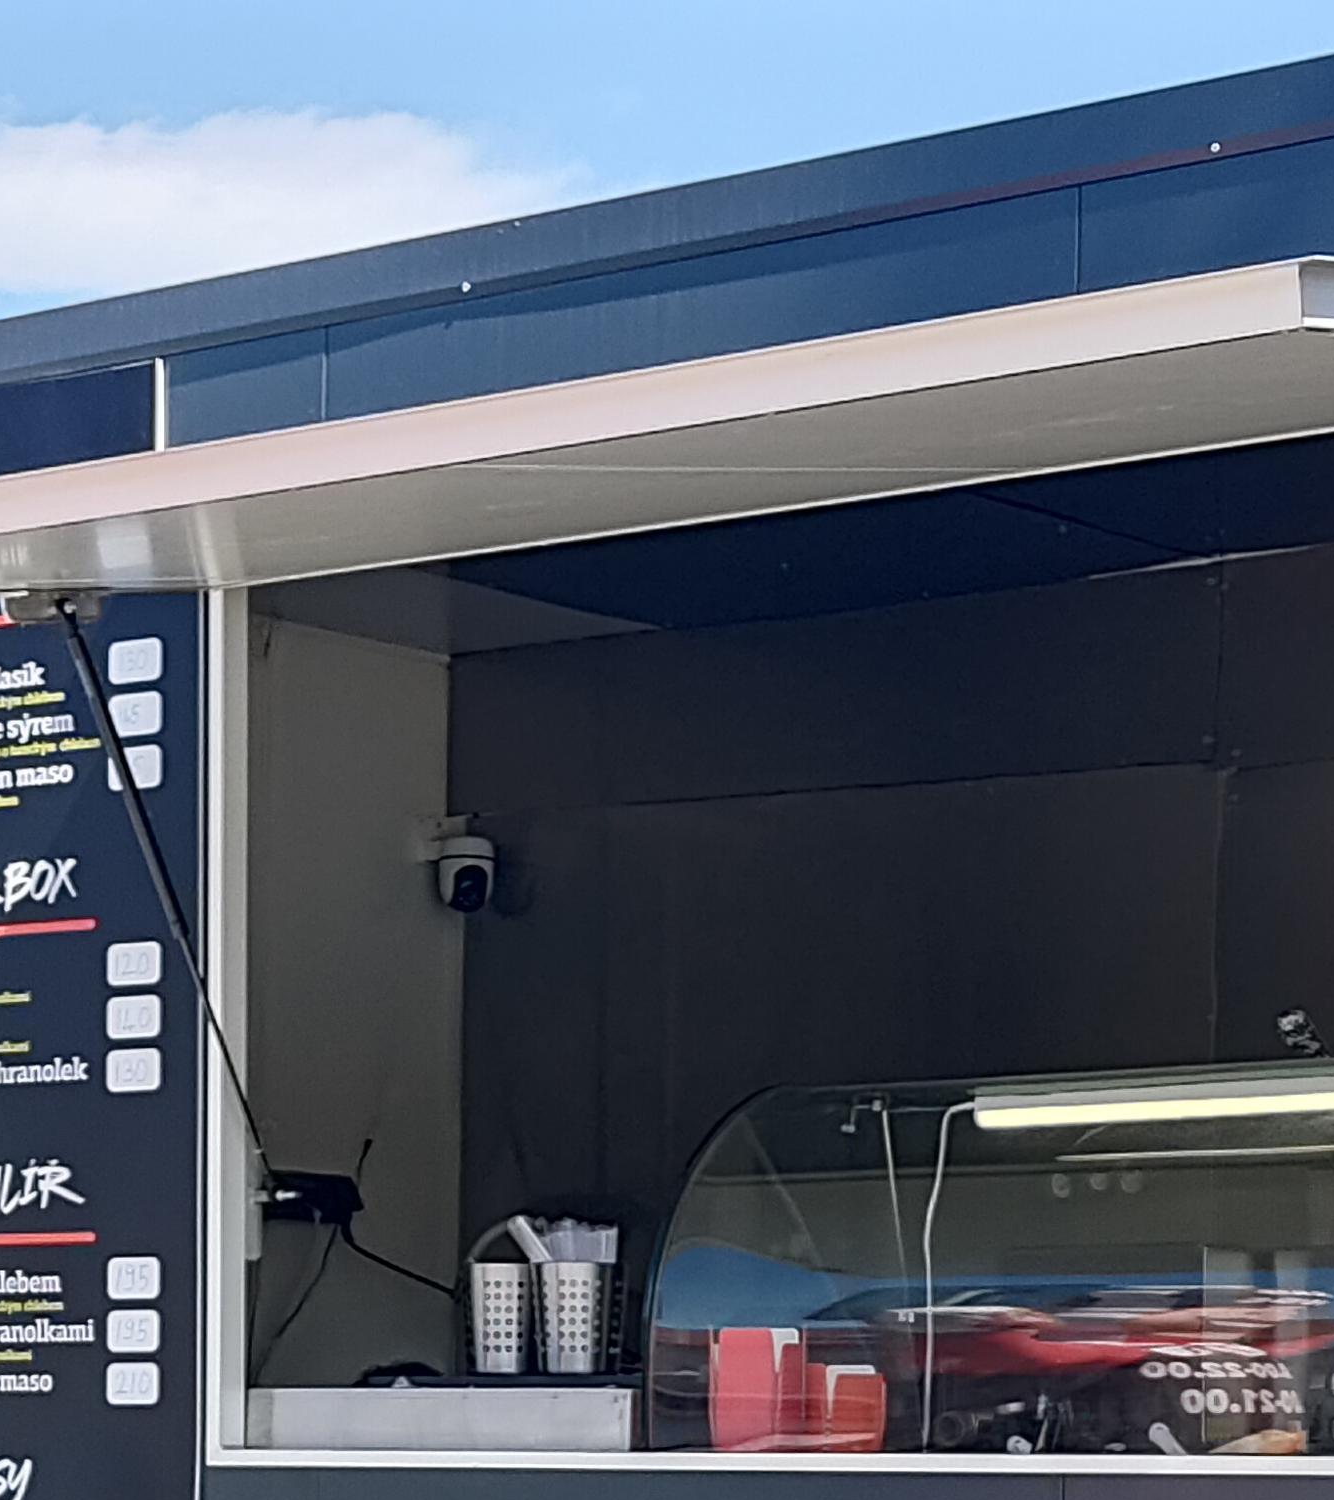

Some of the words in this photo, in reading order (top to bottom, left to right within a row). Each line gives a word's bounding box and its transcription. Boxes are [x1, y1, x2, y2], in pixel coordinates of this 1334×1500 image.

[7, 714, 74, 739] sýrem
[15, 764, 74, 787] maso
[3, 858, 77, 912] BOX
[0, 1370, 54, 1391] maso
